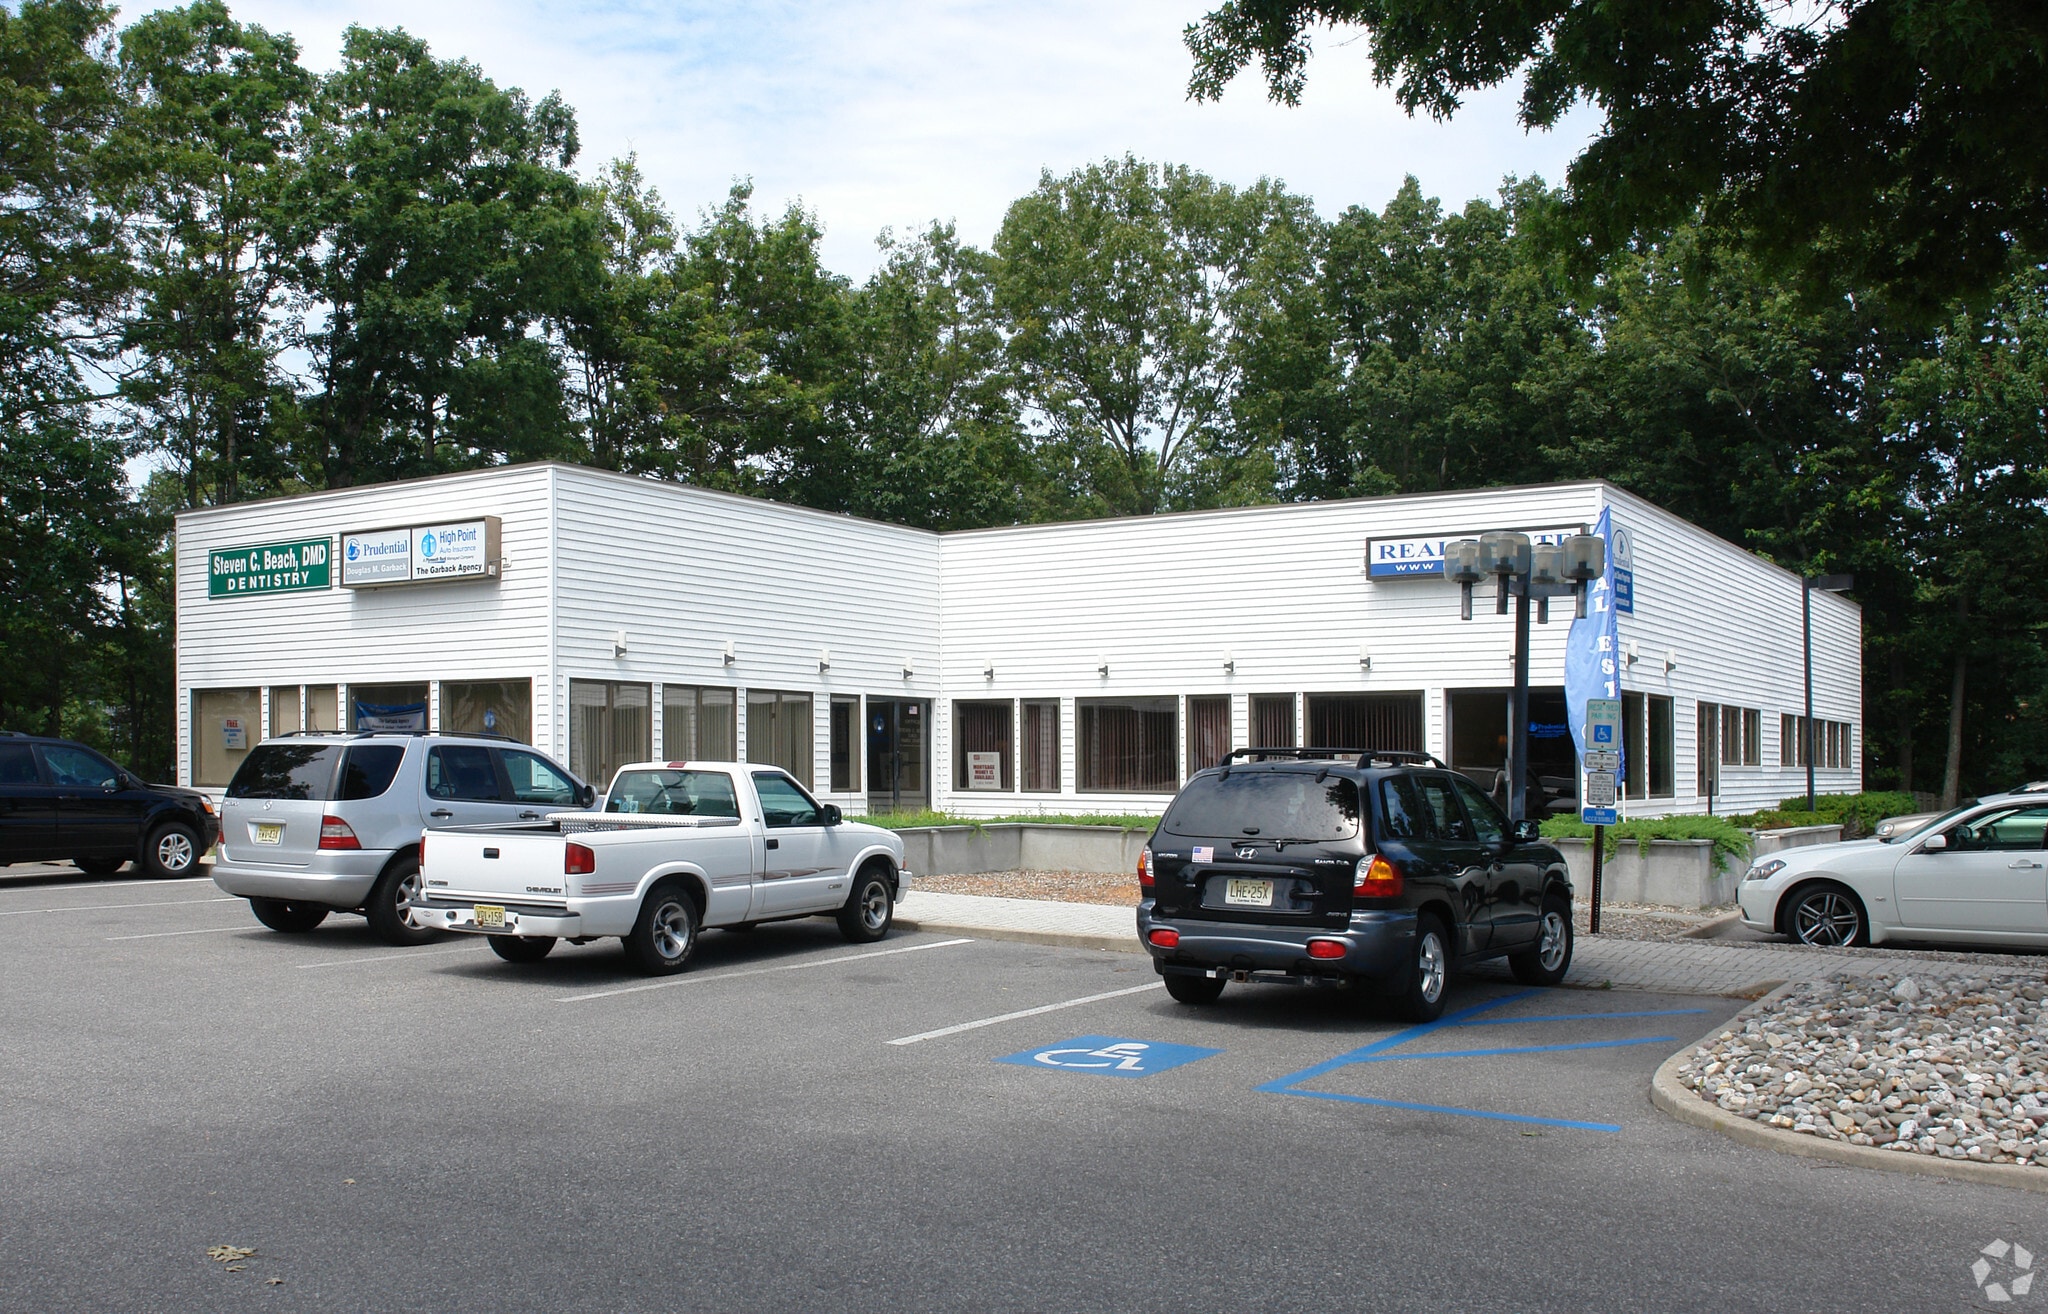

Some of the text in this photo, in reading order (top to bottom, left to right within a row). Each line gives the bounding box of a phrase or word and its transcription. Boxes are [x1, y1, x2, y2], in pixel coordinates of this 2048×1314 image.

[440, 528, 477, 545] High Point
[363, 539, 408, 557] Prudential
[213, 544, 326, 575] Steven C. Beach, DMD
[346, 562, 407, 577] Douglas M. Garback
[416, 563, 482, 575] The Garback Agency
[227, 571, 309, 591] DENTISTRY
